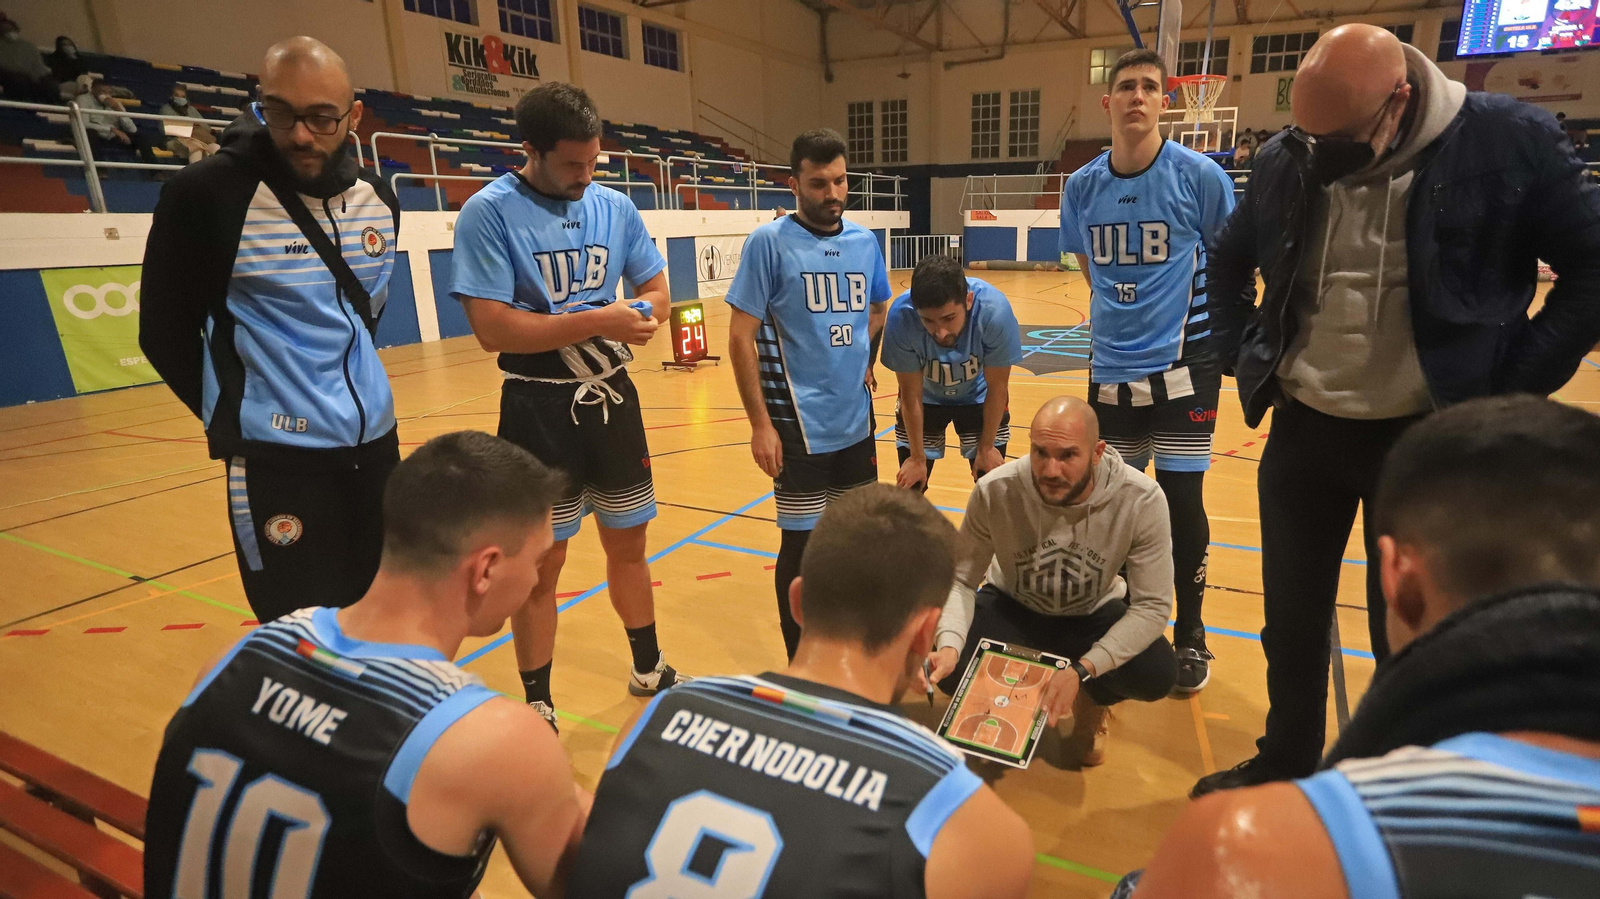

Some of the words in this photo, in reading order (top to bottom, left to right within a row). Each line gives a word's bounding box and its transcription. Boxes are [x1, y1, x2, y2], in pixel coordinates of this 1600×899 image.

[1507, 35, 1530, 49] 15
[1088, 220, 1170, 266] ULB
[532, 244, 609, 304] ULB
[800, 272, 867, 313] ULB
[1113, 282, 1137, 304] 15
[681, 324, 704, 355] 24
[829, 324, 853, 347] 20
[271, 412, 309, 433] ULB
[252, 677, 349, 746] YOME
[661, 709, 888, 812] CHERNODOLIA
[171, 747, 333, 899] 10
[623, 788, 785, 899] 8
